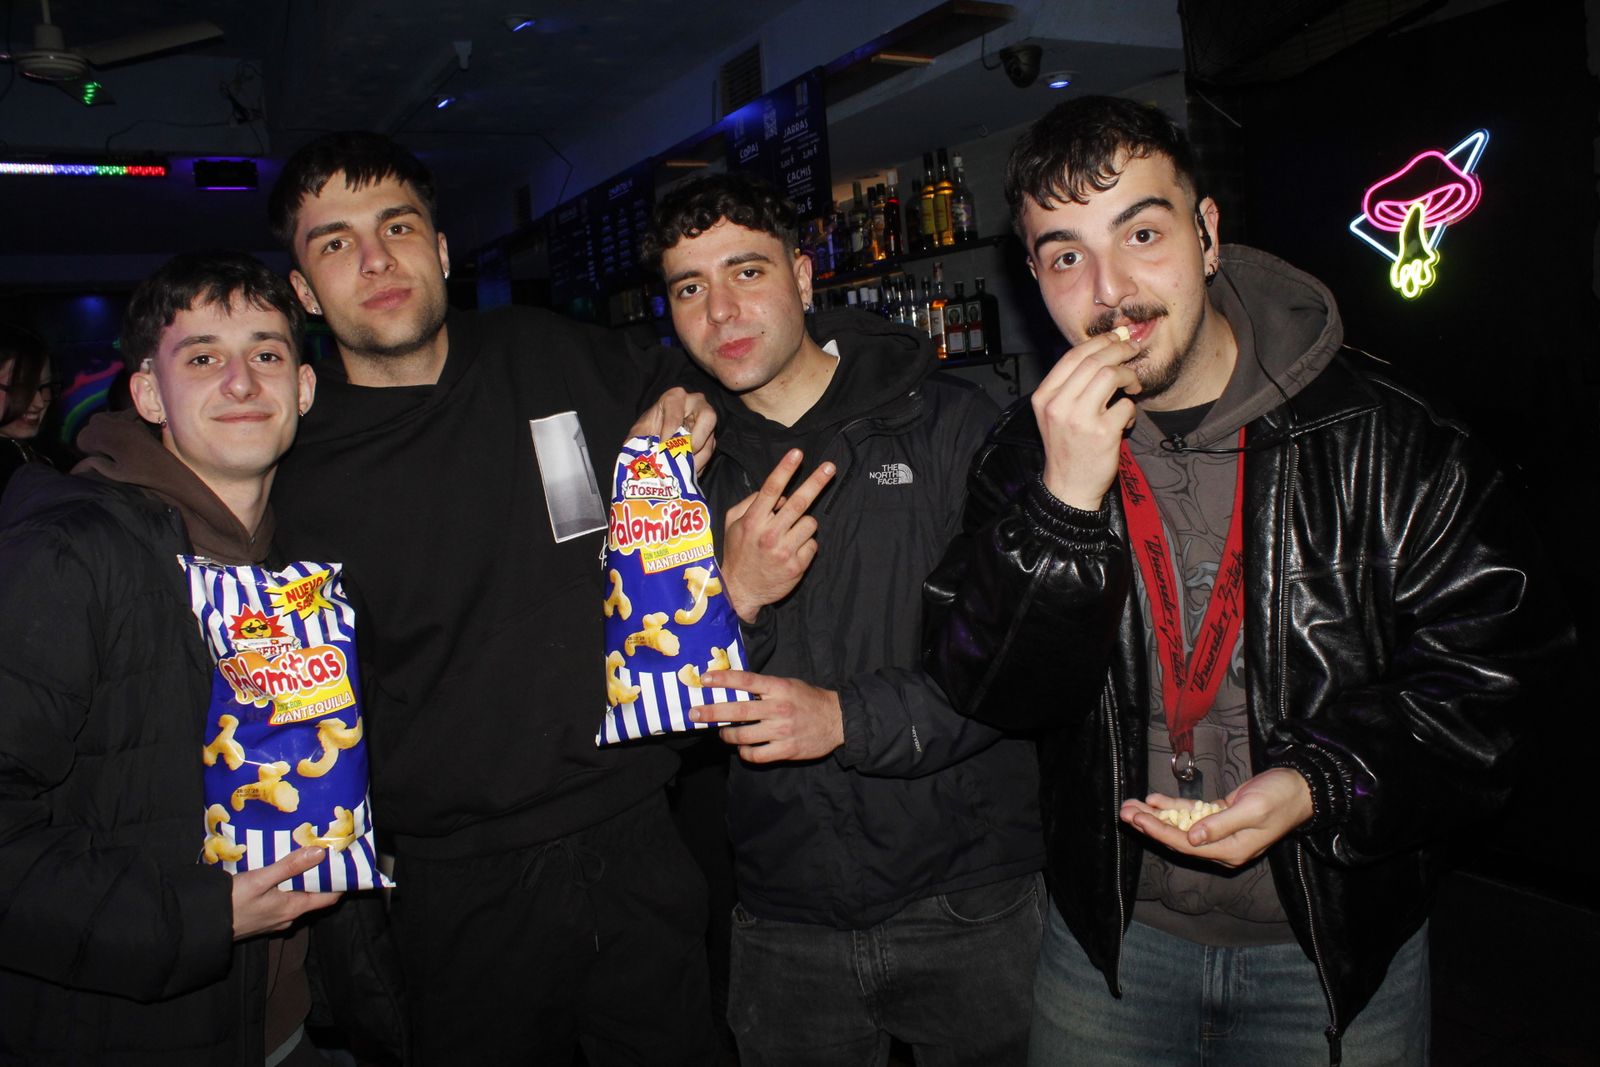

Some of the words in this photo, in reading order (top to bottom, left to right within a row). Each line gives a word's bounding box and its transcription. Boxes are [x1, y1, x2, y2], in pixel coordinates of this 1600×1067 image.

[739, 142, 759, 160] COPAS
[786, 165, 812, 183] CACHIS
[666, 438, 689, 450] SABOR
[869, 470, 898, 479] NORTH
[881, 463, 898, 471] THE
[629, 484, 674, 498] TOSFRIT
[877, 478, 899, 486] FACE
[610, 503, 705, 546] Palomitas
[646, 544, 714, 572] MANTEQUILLA
[285, 577, 323, 604] NUEVO
[274, 692, 353, 724] MANTEQUILLA
